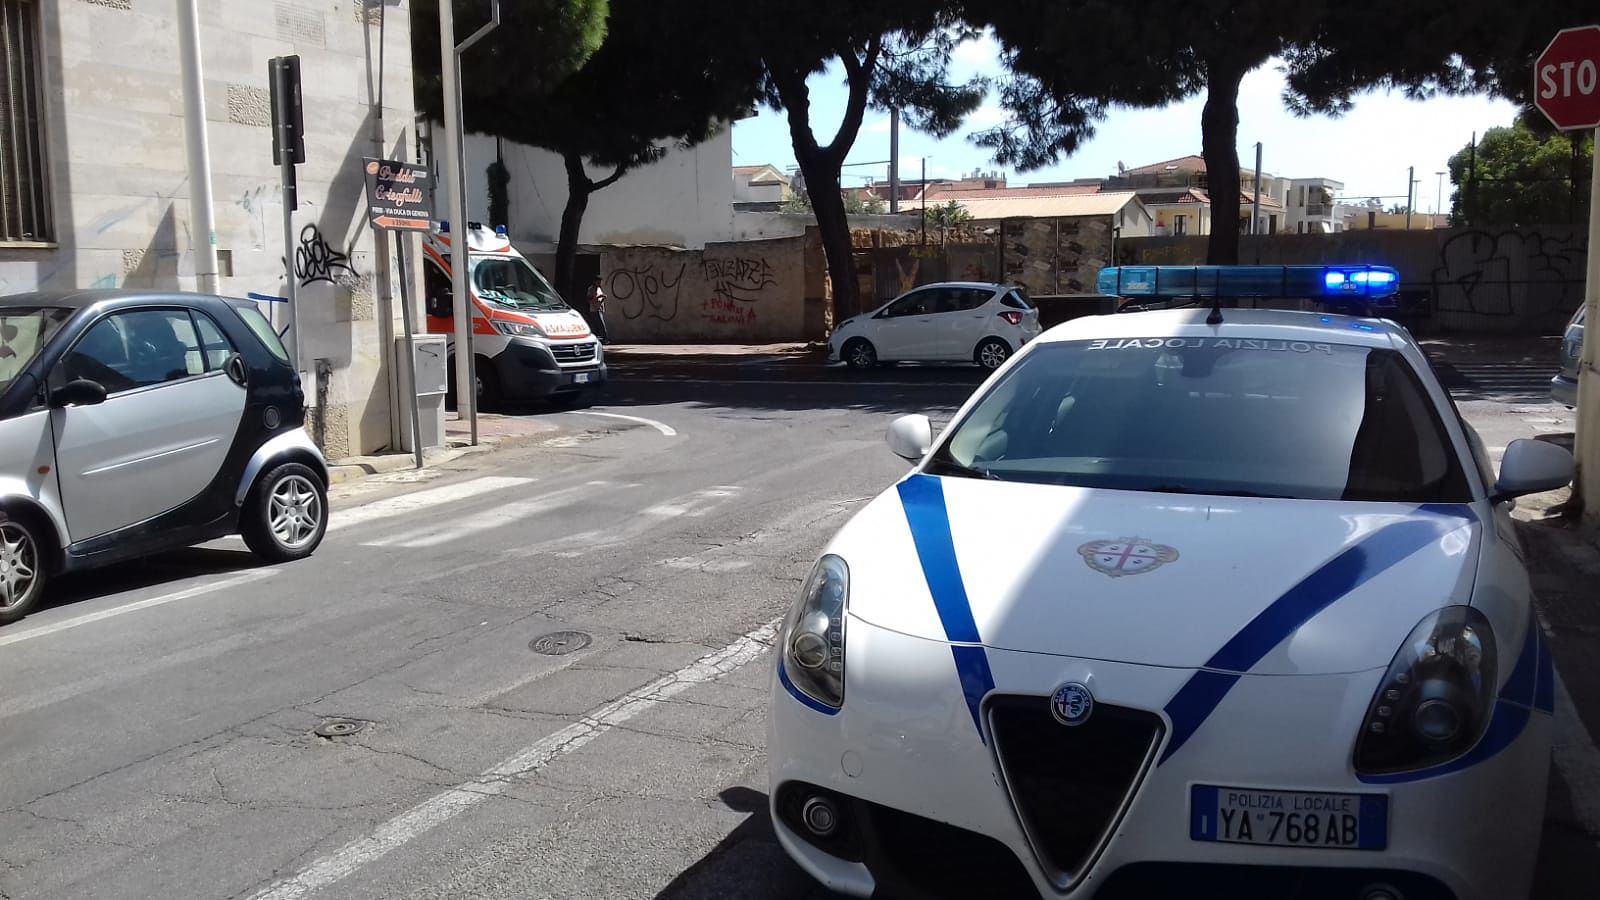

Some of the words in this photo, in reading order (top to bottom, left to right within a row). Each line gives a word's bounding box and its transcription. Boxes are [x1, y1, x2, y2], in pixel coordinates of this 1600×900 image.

[1541, 59, 1597, 99] STO
[385, 207, 394, 215] VIA
[393, 208, 406, 216] DUCA
[406, 209, 412, 217] DI
[1228, 793, 1284, 809] POLIZIA
[1294, 798, 1350, 812] LOCALE
[1220, 808, 1253, 841] YA
